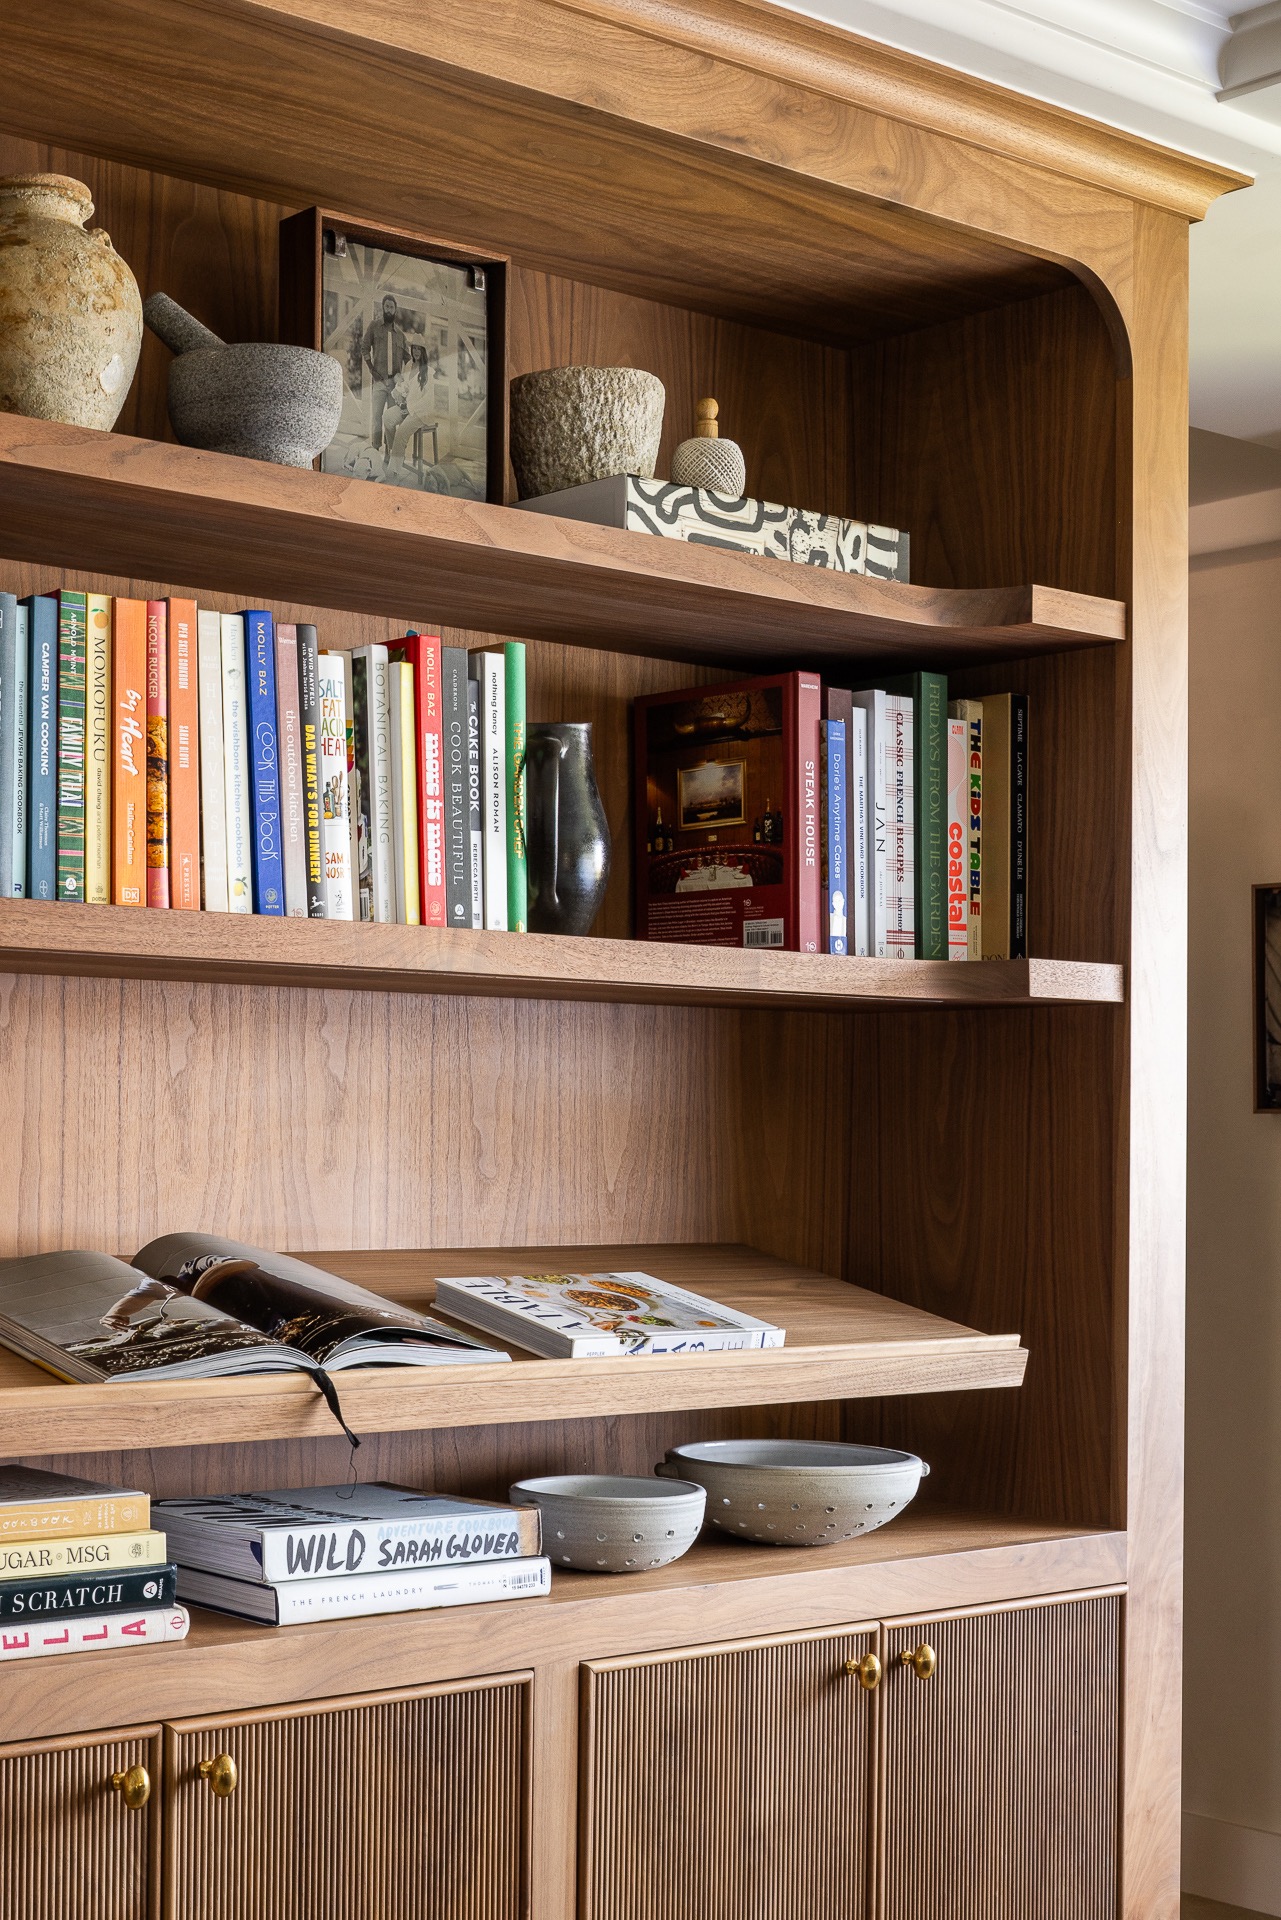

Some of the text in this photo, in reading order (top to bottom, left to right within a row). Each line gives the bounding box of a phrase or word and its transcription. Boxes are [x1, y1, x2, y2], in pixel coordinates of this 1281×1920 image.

[148, 615, 158, 699] NICOLE RUCKER
[178, 622, 189, 690] OPEN SKIES COOKBOOK
[256, 622, 268, 696] MOLLY BAZ
[307, 647, 315, 670] DAVID
[318, 678, 344, 699] SALT
[426, 647, 436, 717] MOLLY BAZ
[40, 642, 50, 776] CAMPER VAN COOKING
[93, 637, 106, 762] MOMOFUKU
[119, 688, 144, 776] by Heart
[178, 725, 190, 746] SARAH
[320, 717, 345, 738] ACID
[322, 698, 342, 718] FAT
[61, 716, 83, 807] FAMILY THAI
[205, 682, 220, 858] HARVEST
[375, 662, 390, 844] BOTANICAL BAKING
[468, 715, 479, 760] CAKE
[970, 718, 982, 770] THE
[1017, 752, 1023, 763] LA
[16, 789, 24, 834] COOKBOOK
[95, 788, 105, 810] chang
[96, 767, 105, 786] david
[231, 700, 243, 869] the wishbone kitchen cookbook
[256, 721, 279, 861] COOK THIS BOOK
[285, 710, 301, 843] the outdoor kitchen
[305, 724, 322, 884] DAD, WHAT'S FOR DINNER?
[424, 732, 443, 887] more is more
[450, 721, 464, 885] COOK BEAUTIFUL
[469, 764, 480, 812] BOOK
[513, 721, 525, 860] THE GARDEN CHEF
[896, 712, 905, 883] CLASSIC FRENCH RECIPES
[805, 760, 815, 867] STEAK HOUSE
[832, 753, 842, 879] Dorie's Anytime Cakes
[929, 683, 942, 957] FRIDAYS FROM THE GARDEN
[124, 890, 138, 900] DK
[948, 821, 968, 932] coastal
[969, 836, 981, 916] TABLE
[66, 1544, 110, 1565] MSG
[286, 1528, 520, 1575] WILD SARAH GLOVER
[376, 1520, 454, 1542] ADVENTURE
[12, 1583, 124, 1613] SCRATCH
[157, 1577, 165, 1600] ABRAMS
[291, 1587, 424, 1607] THE FRENCH LAUNDRY
